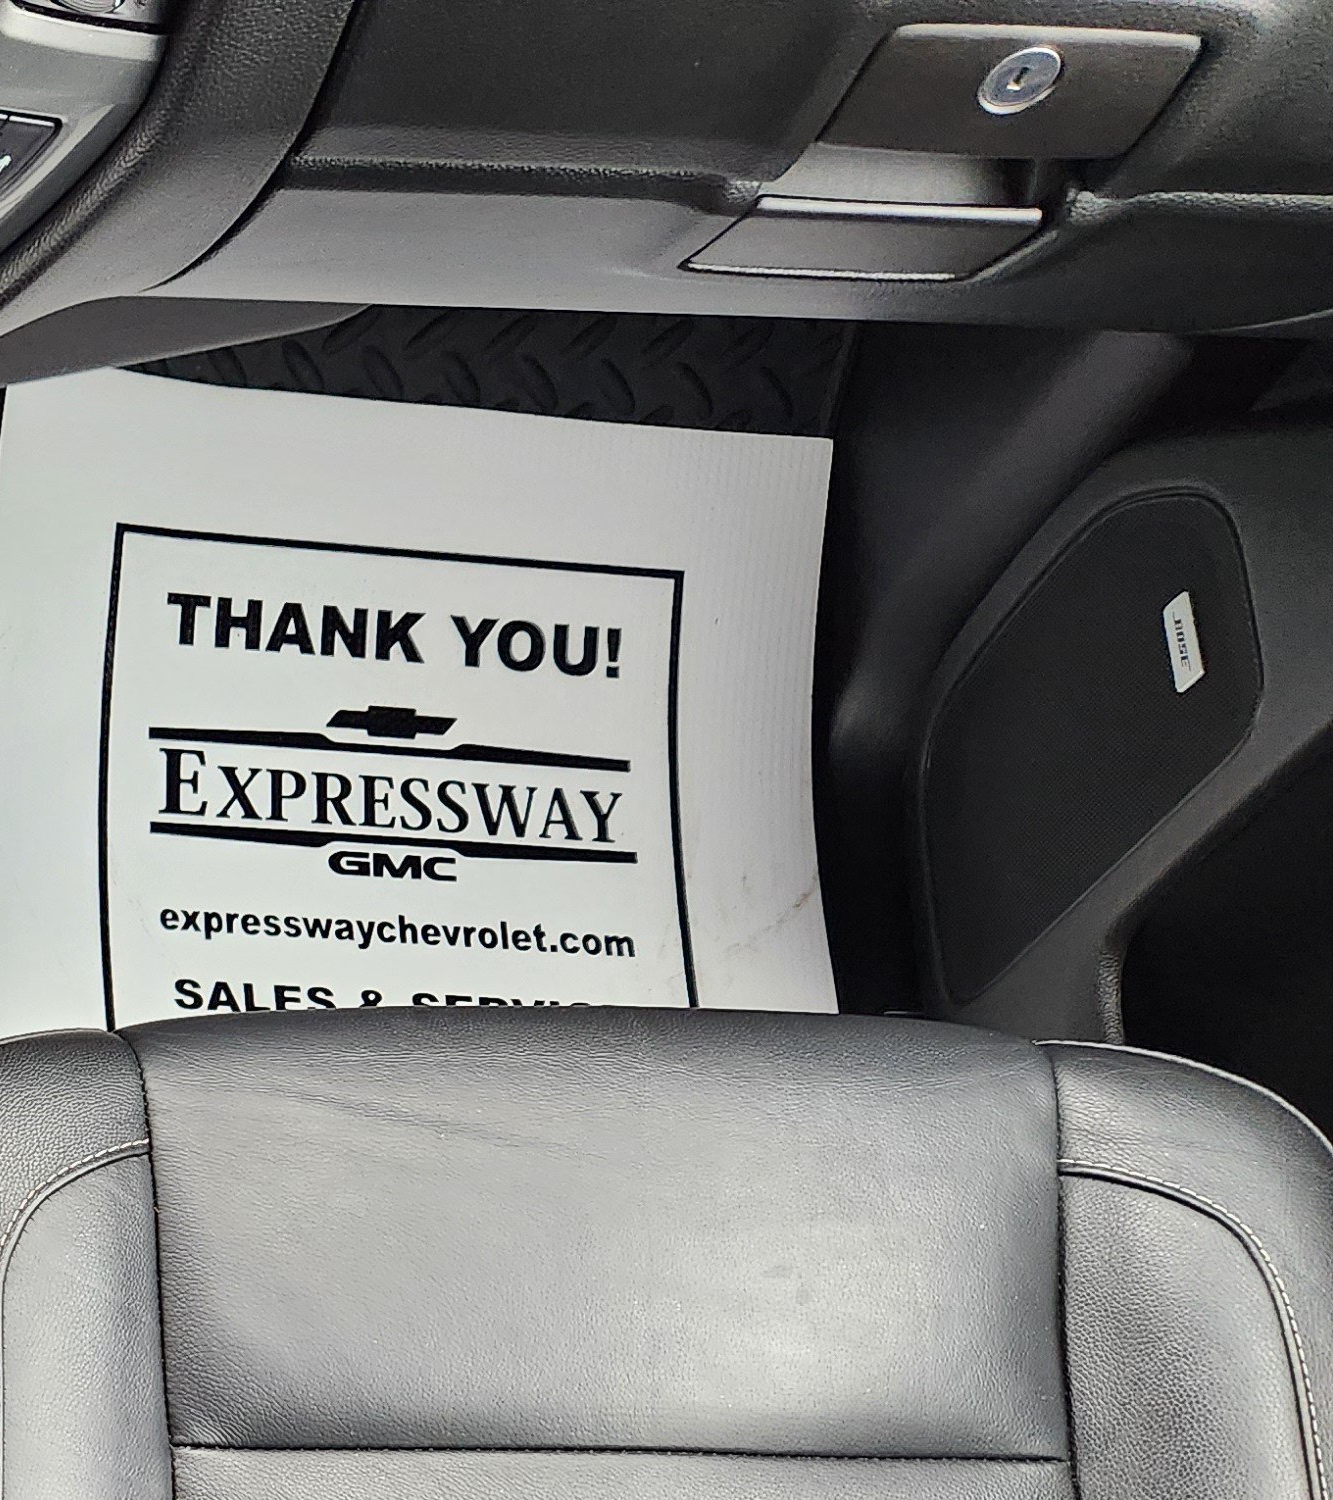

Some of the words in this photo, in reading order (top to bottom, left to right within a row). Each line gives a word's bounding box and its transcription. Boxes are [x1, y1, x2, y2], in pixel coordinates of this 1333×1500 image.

[166, 592, 425, 664] THANK
[450, 614, 623, 679] YOU!
[159, 747, 622, 843] EXPRESSWAY
[328, 851, 457, 883] GMC
[160, 907, 636, 958] expresswaychevrolet.com
[174, 978, 337, 1012] SALES
